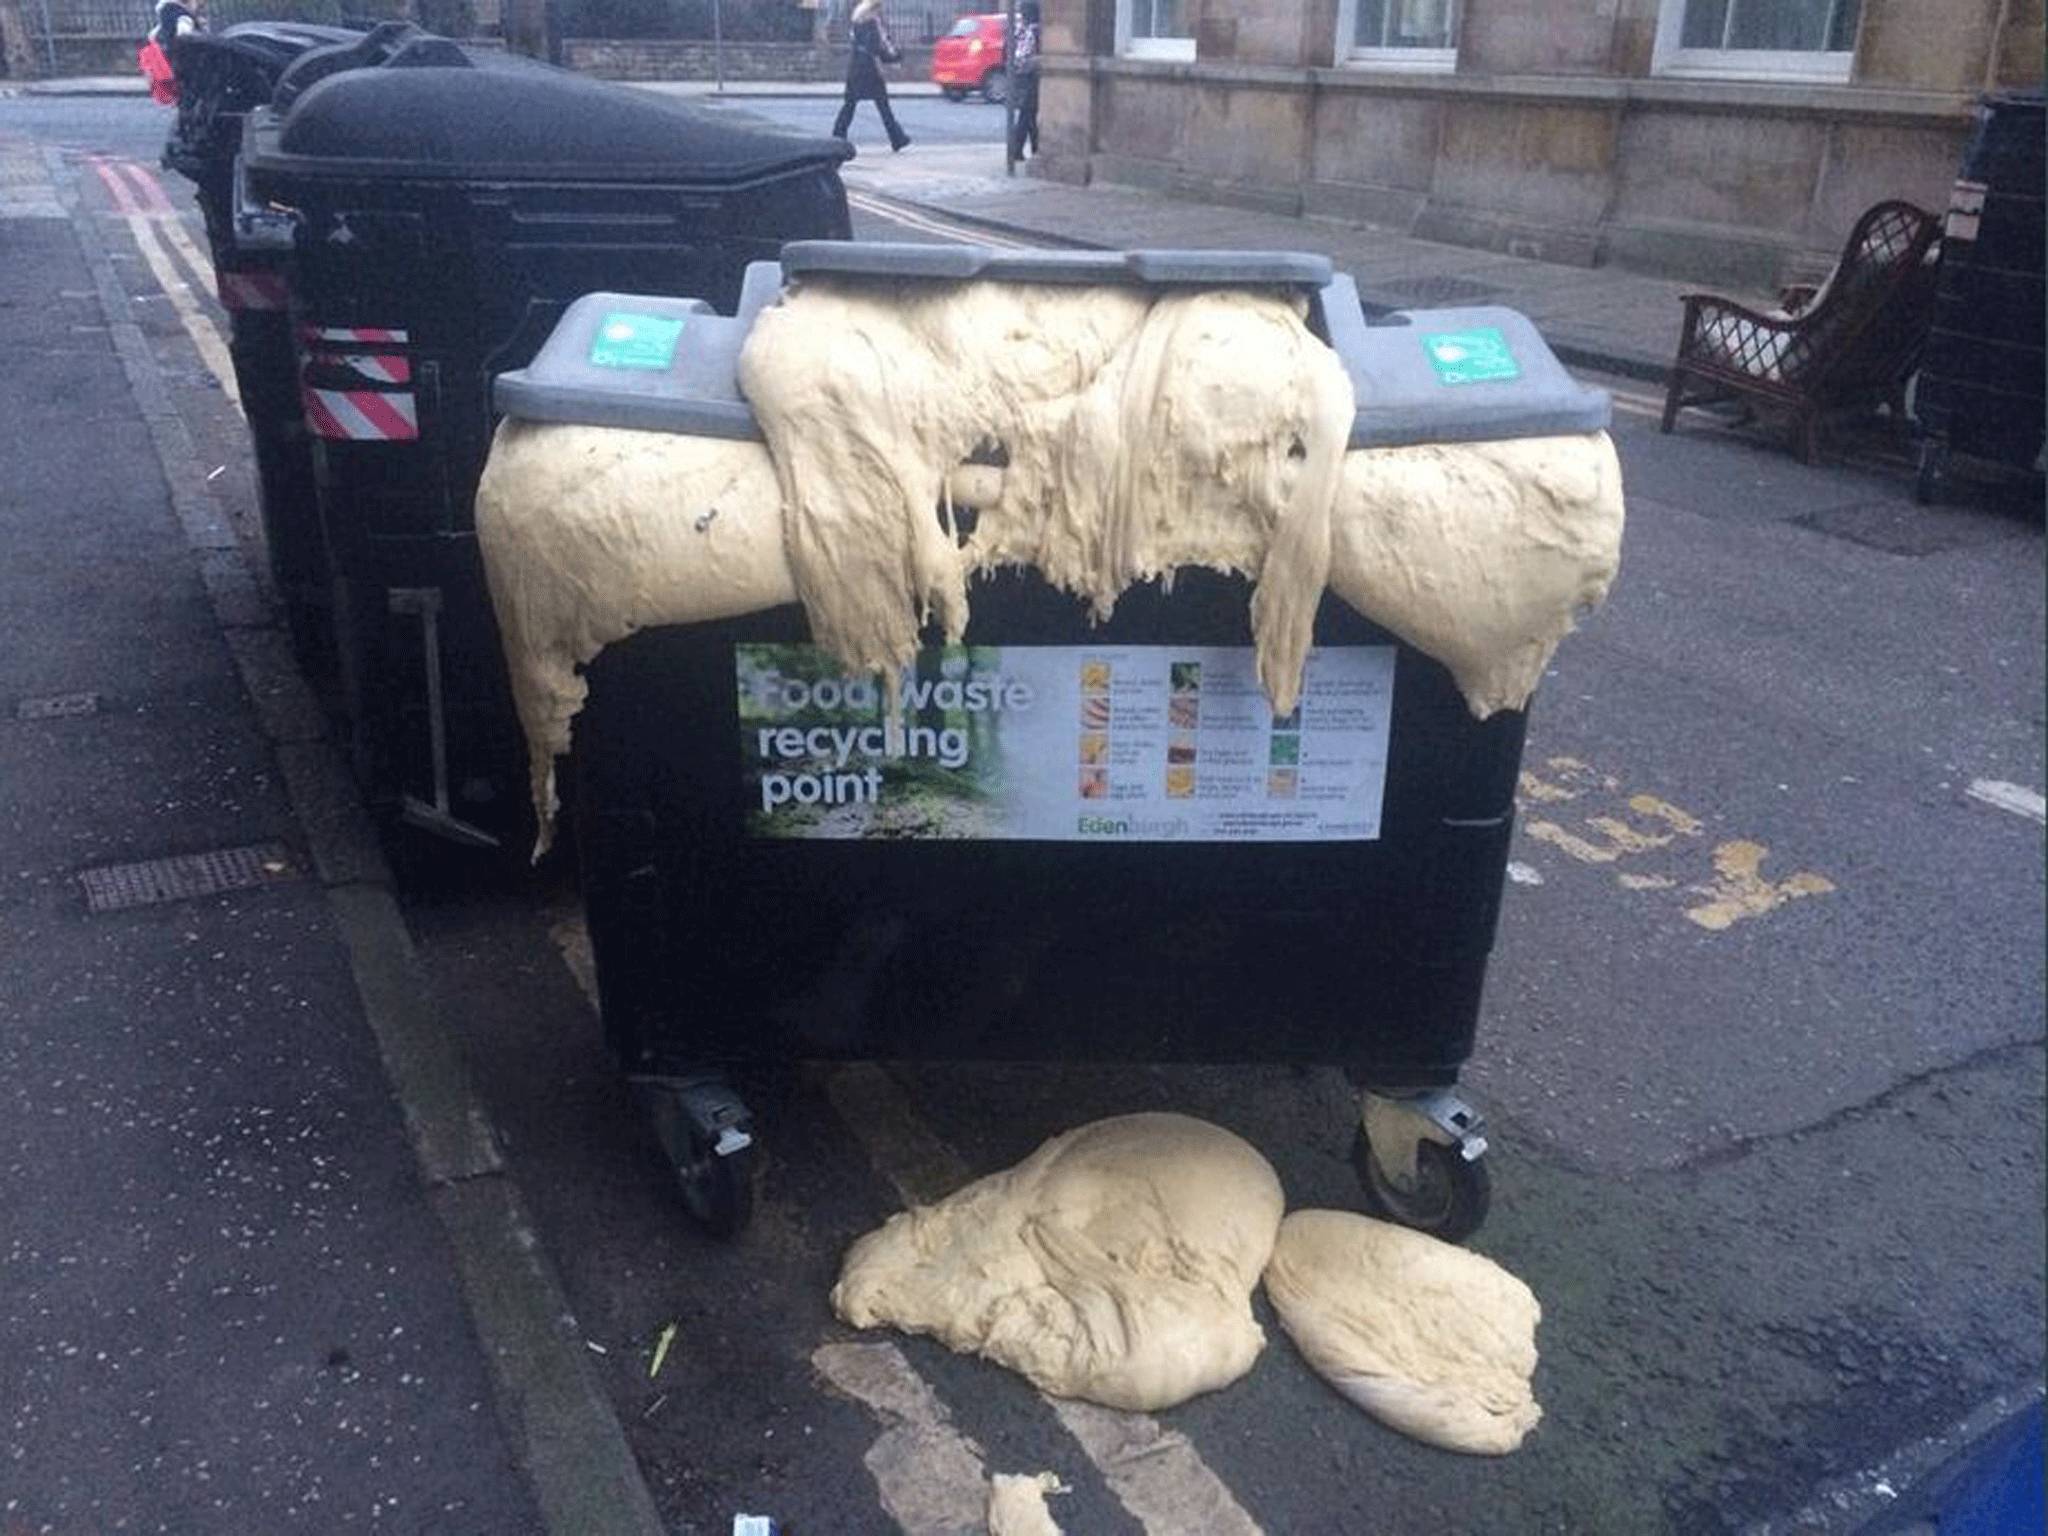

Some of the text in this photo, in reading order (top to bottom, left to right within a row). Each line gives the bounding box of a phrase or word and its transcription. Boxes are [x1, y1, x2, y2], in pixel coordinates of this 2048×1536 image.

[759, 669, 1034, 711] Food waste
[758, 717, 968, 768] recycling
[761, 768, 883, 813] point
